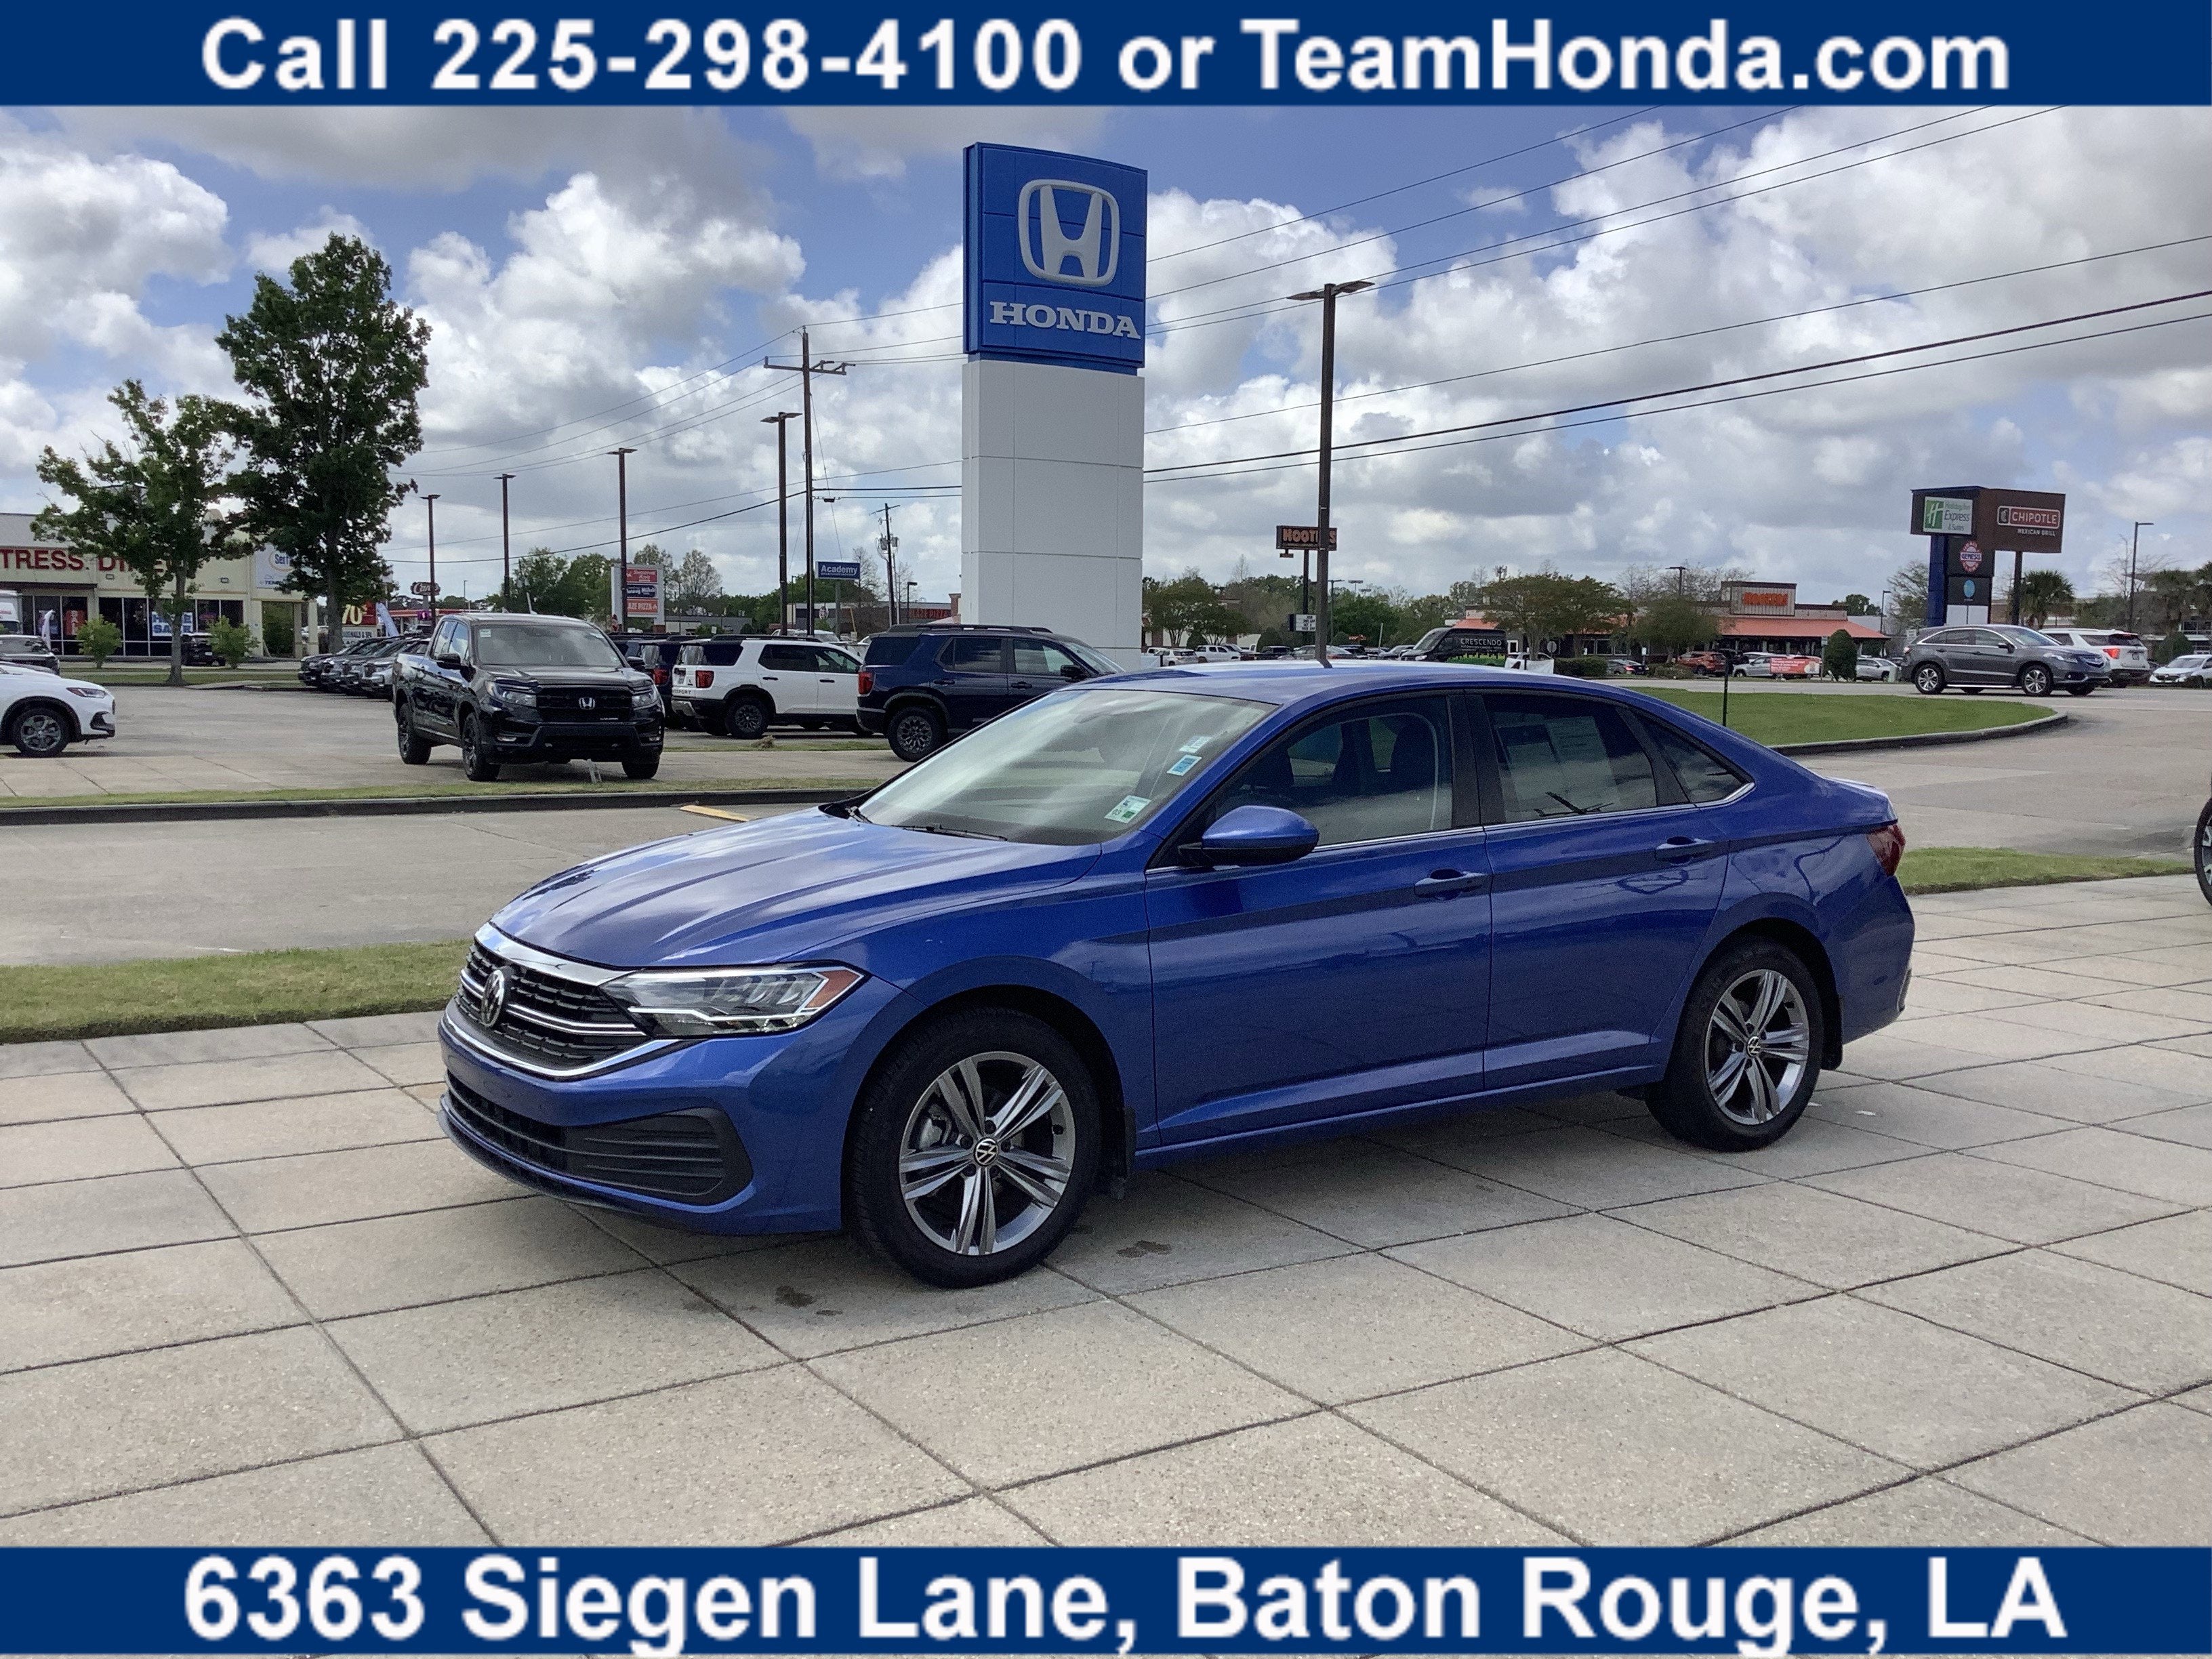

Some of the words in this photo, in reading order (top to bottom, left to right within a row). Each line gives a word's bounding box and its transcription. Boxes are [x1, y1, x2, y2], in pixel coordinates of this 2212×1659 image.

[989, 301, 1141, 340] HONDA
[1944, 510, 1971, 522] Express
[2011, 512, 2058, 525] CHIPOTLE
[1282, 528, 1337, 544] HOOTS
[821, 565, 858, 576] Academy
[1460, 638, 1502, 647] CRESCENDO
